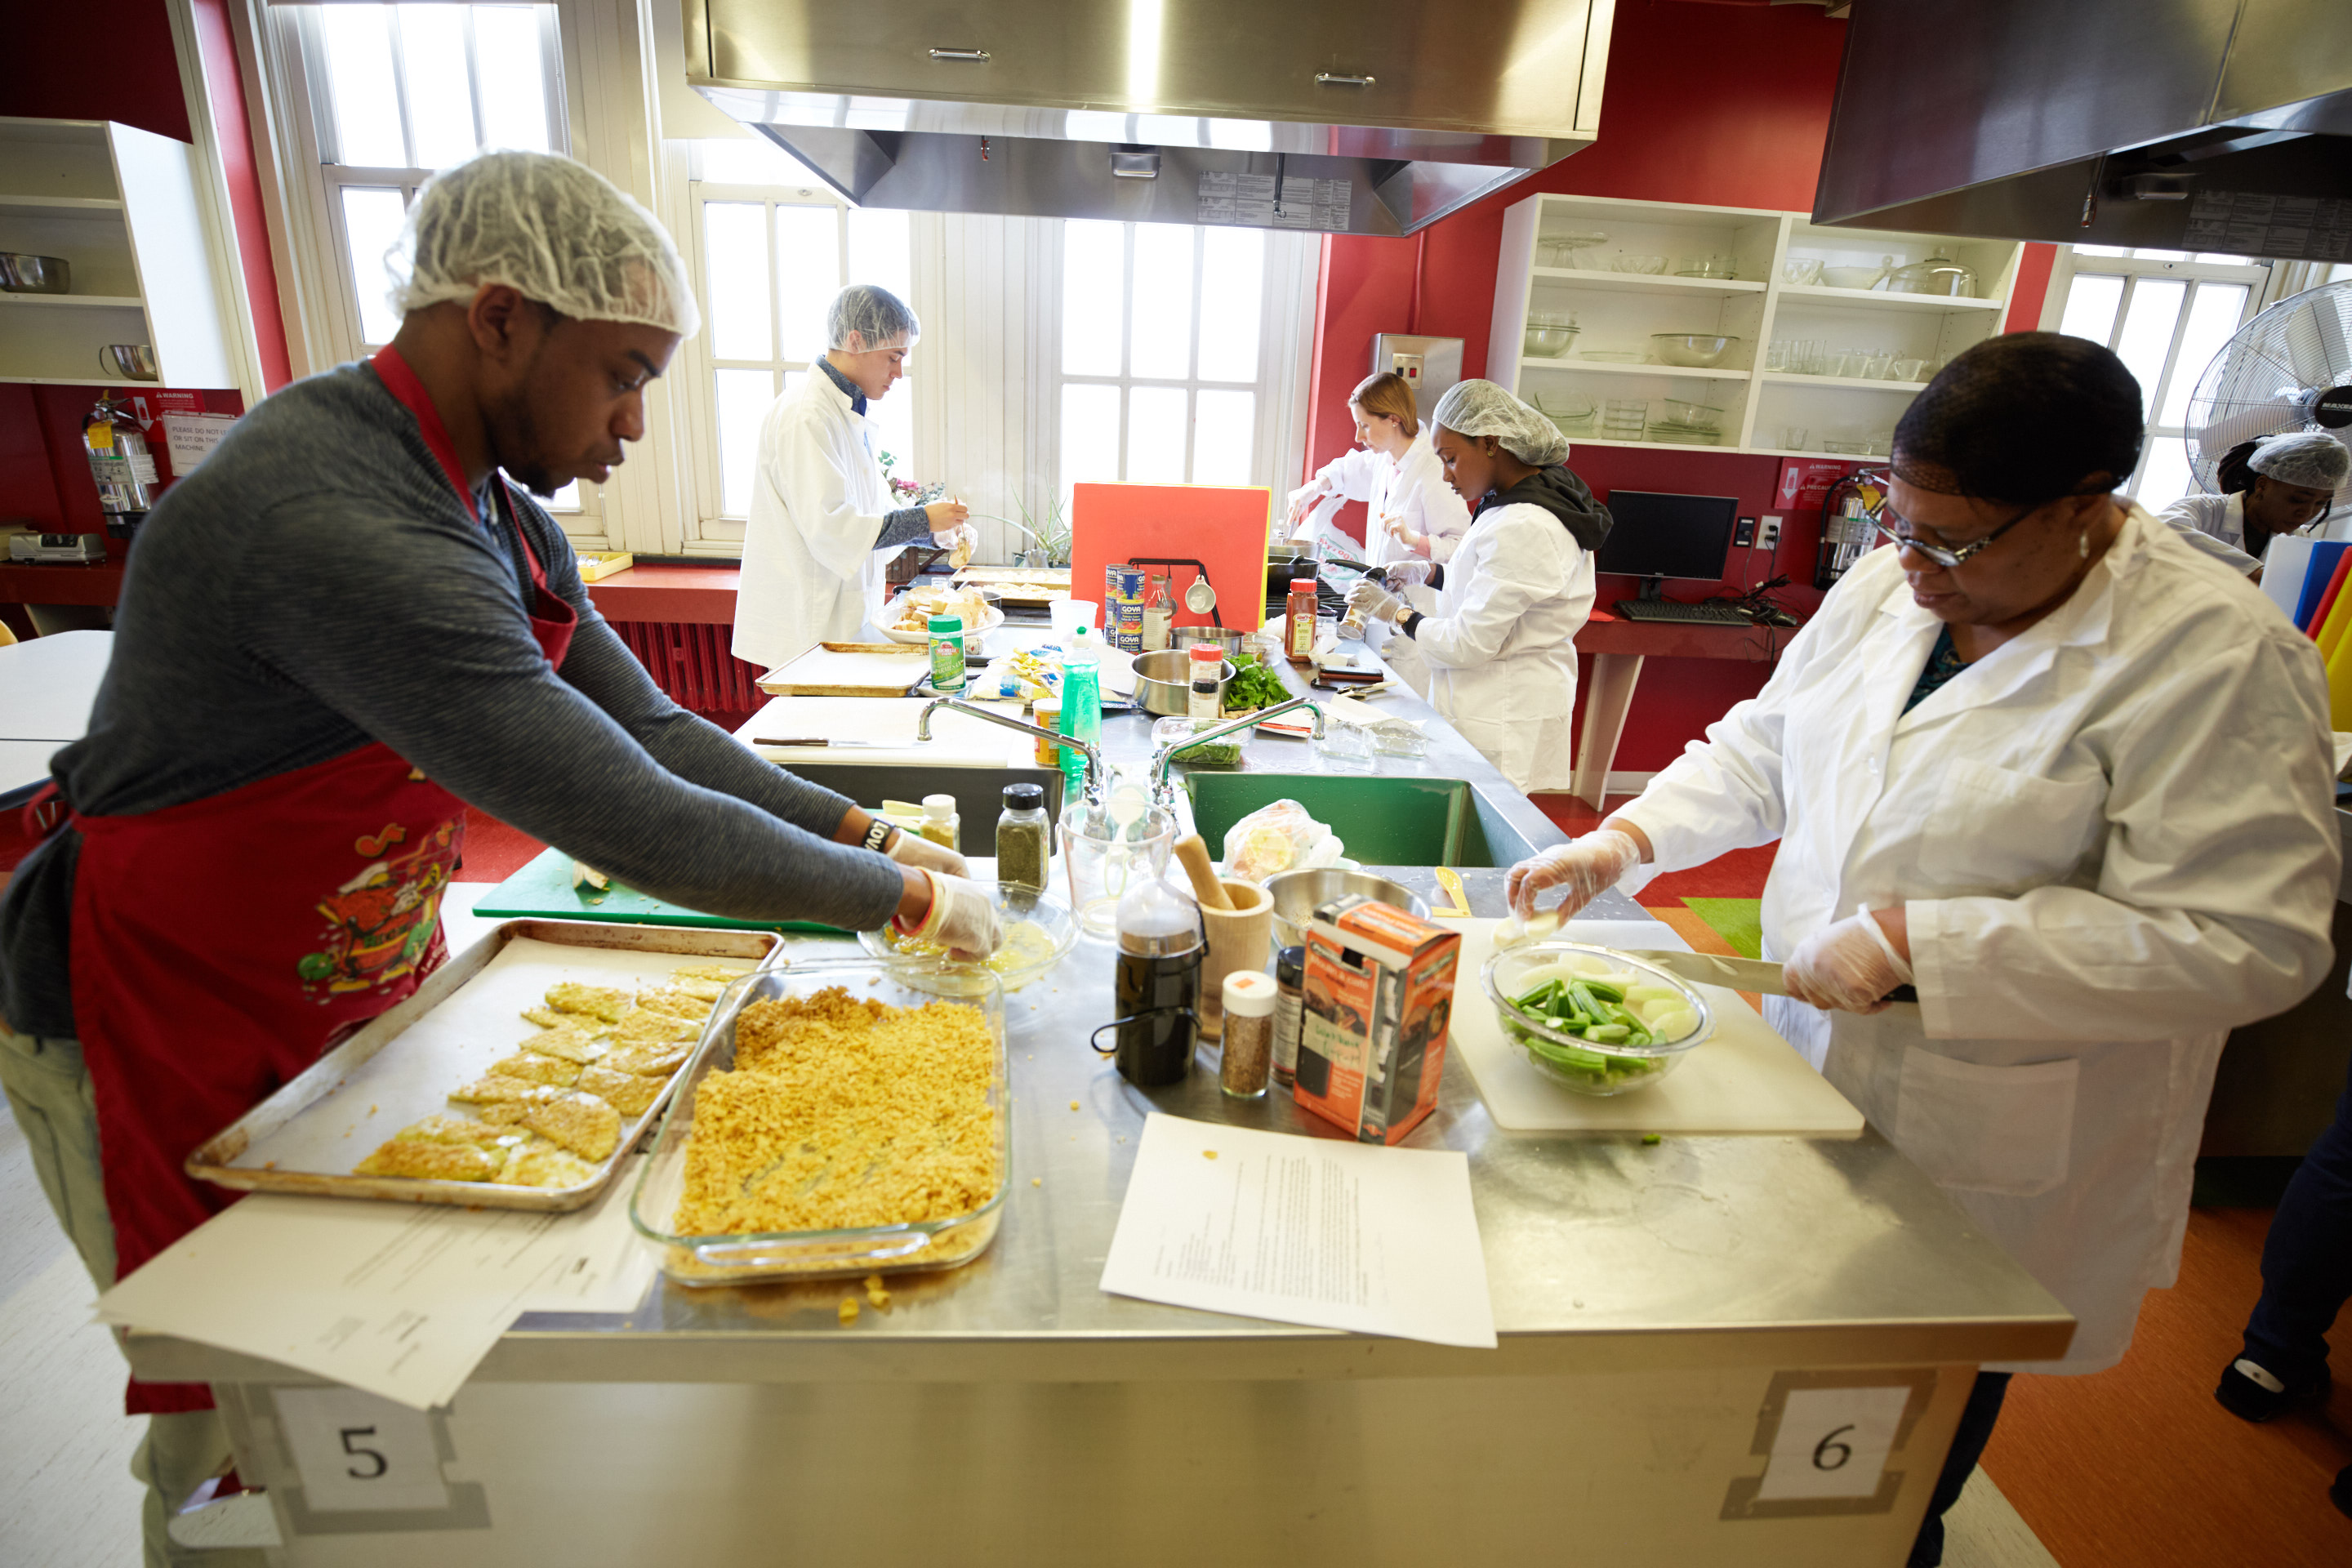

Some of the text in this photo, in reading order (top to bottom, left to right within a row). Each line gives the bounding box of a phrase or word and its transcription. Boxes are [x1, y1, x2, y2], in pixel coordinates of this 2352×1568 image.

[864, 821, 889, 850] LOV
[339, 1425, 389, 1479] 5
[1812, 1424, 1855, 1471] 6
